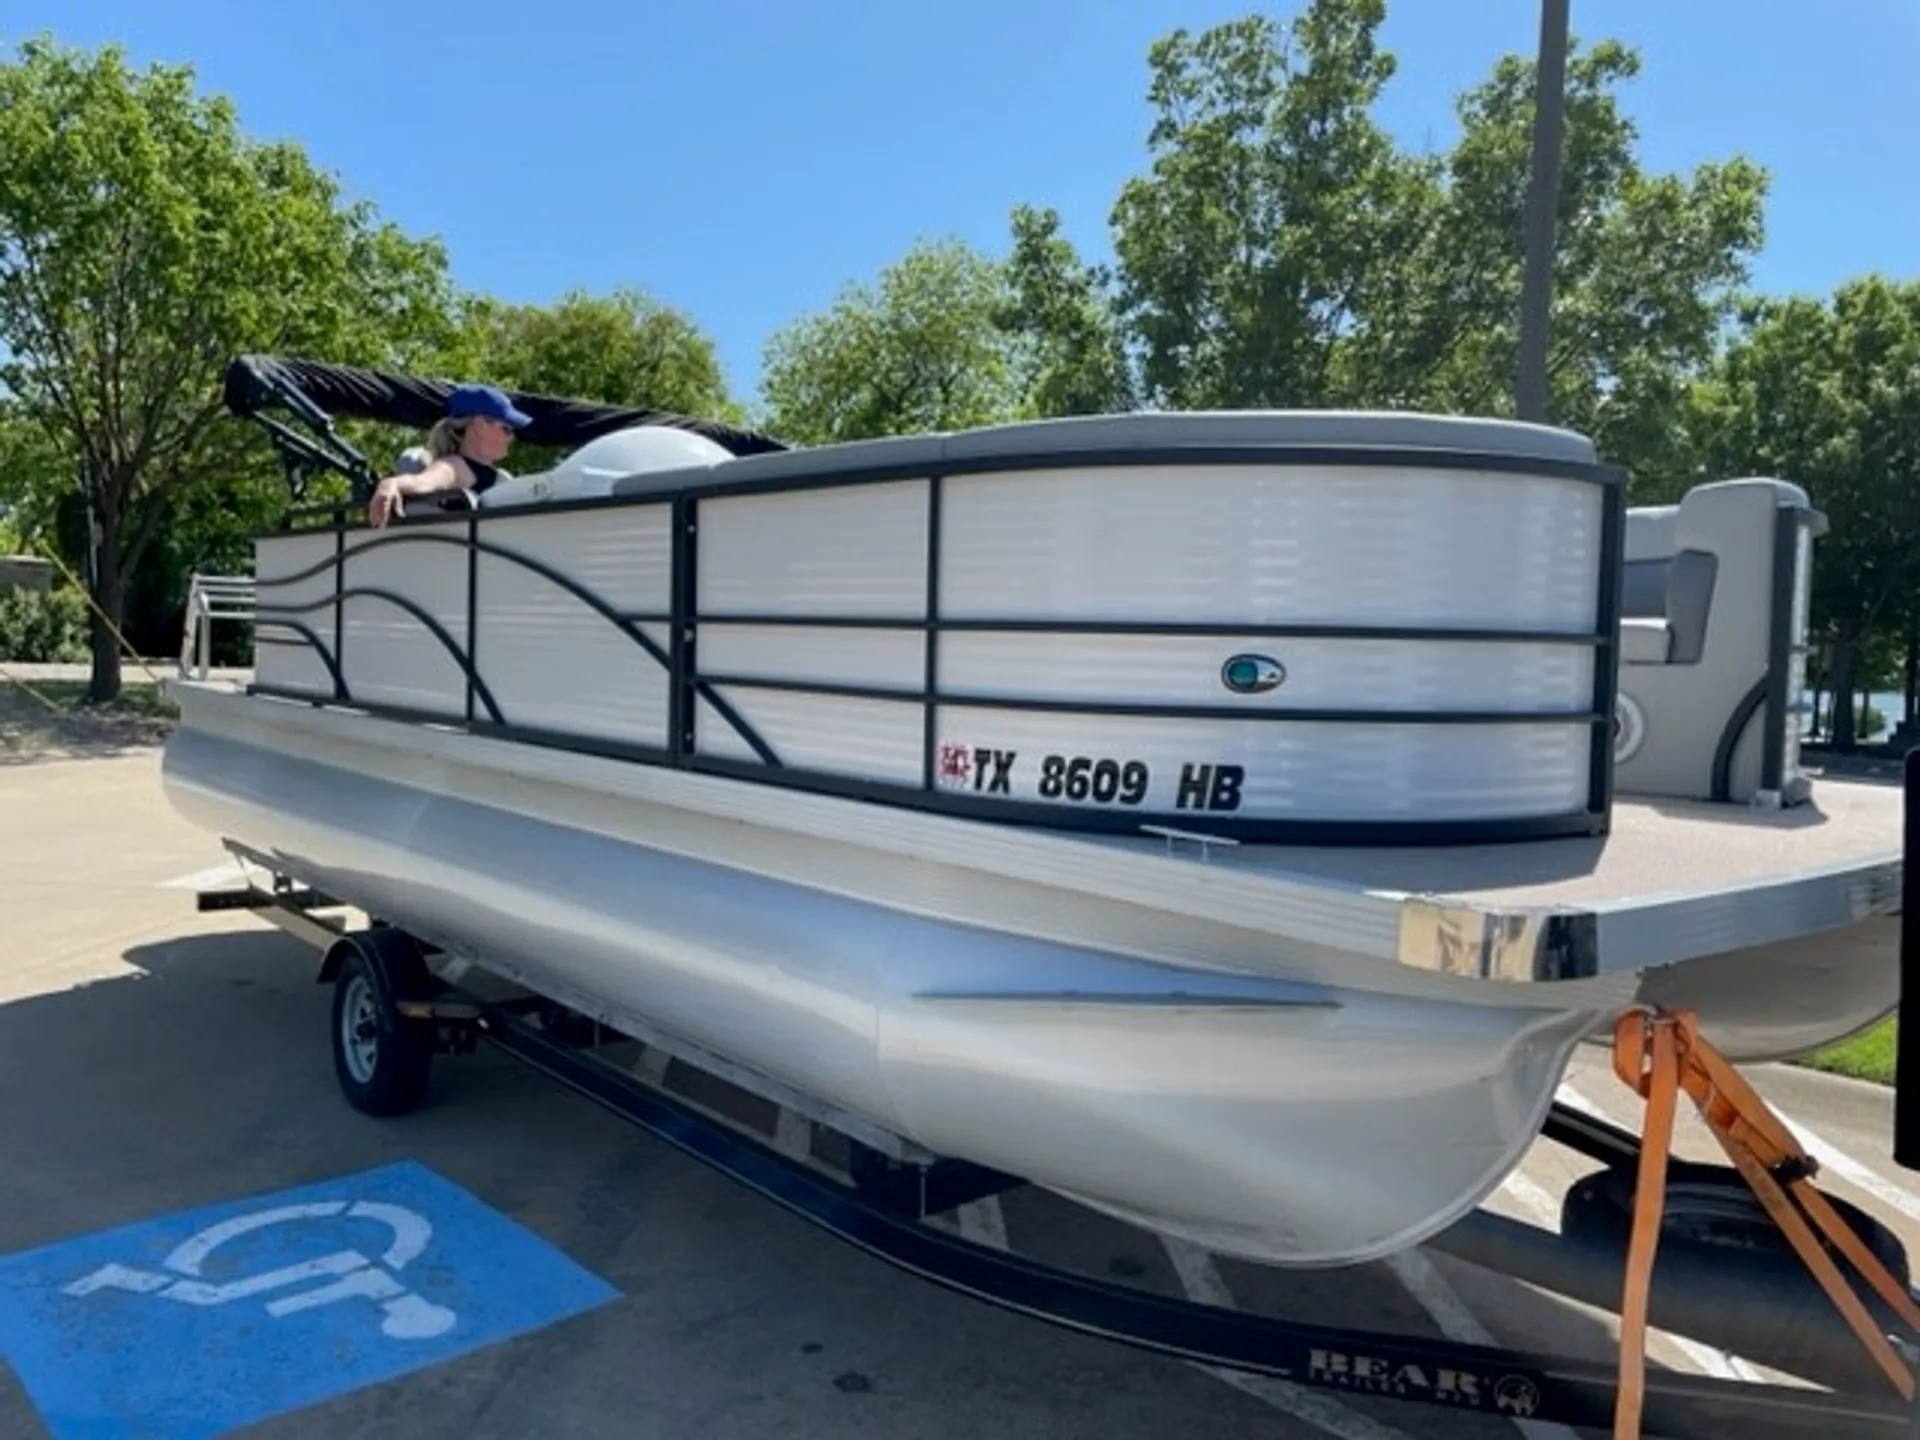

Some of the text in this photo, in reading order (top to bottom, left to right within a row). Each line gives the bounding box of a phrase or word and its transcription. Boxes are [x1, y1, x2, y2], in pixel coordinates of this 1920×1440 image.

[974, 748, 1016, 794] TX
[1039, 755, 1148, 805] 8609
[1177, 763, 1245, 812] HB
[1309, 1350, 1479, 1395] BEAR
